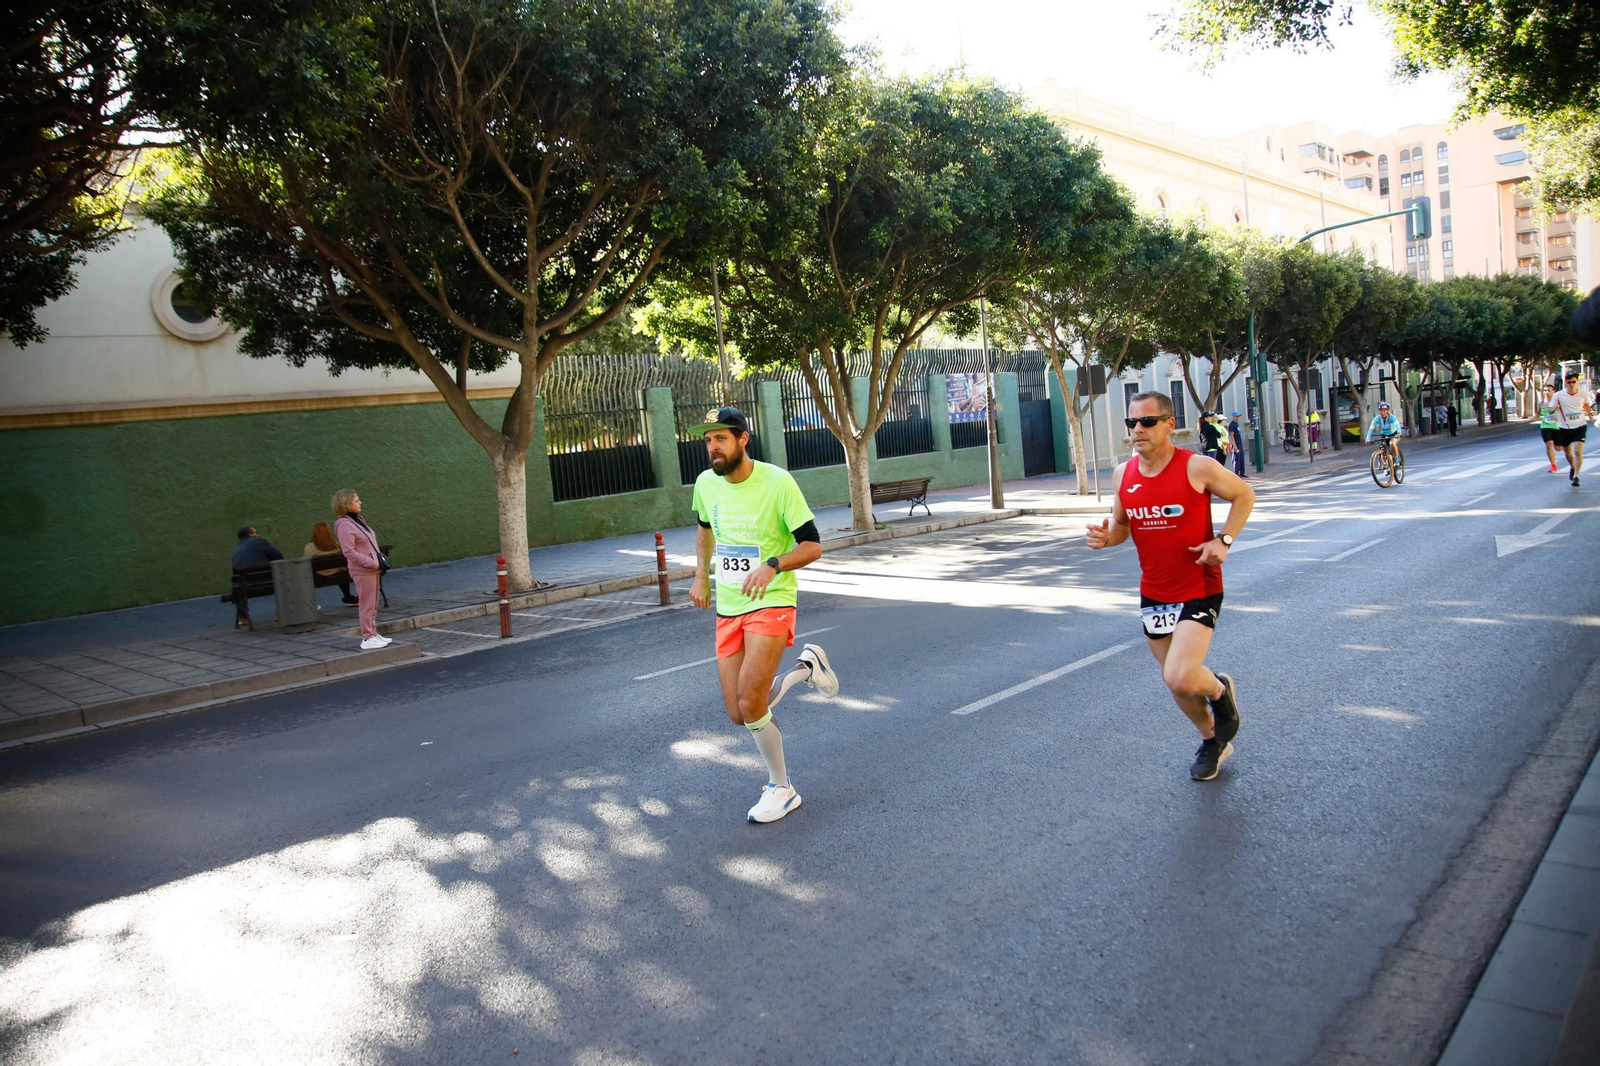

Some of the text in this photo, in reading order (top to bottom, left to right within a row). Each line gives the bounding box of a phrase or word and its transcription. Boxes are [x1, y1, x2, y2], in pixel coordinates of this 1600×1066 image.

[1125, 504, 1185, 520] PULSO
[720, 521, 758, 529] contra el
[723, 557, 751, 572] 833
[1152, 612, 1176, 628] 213
